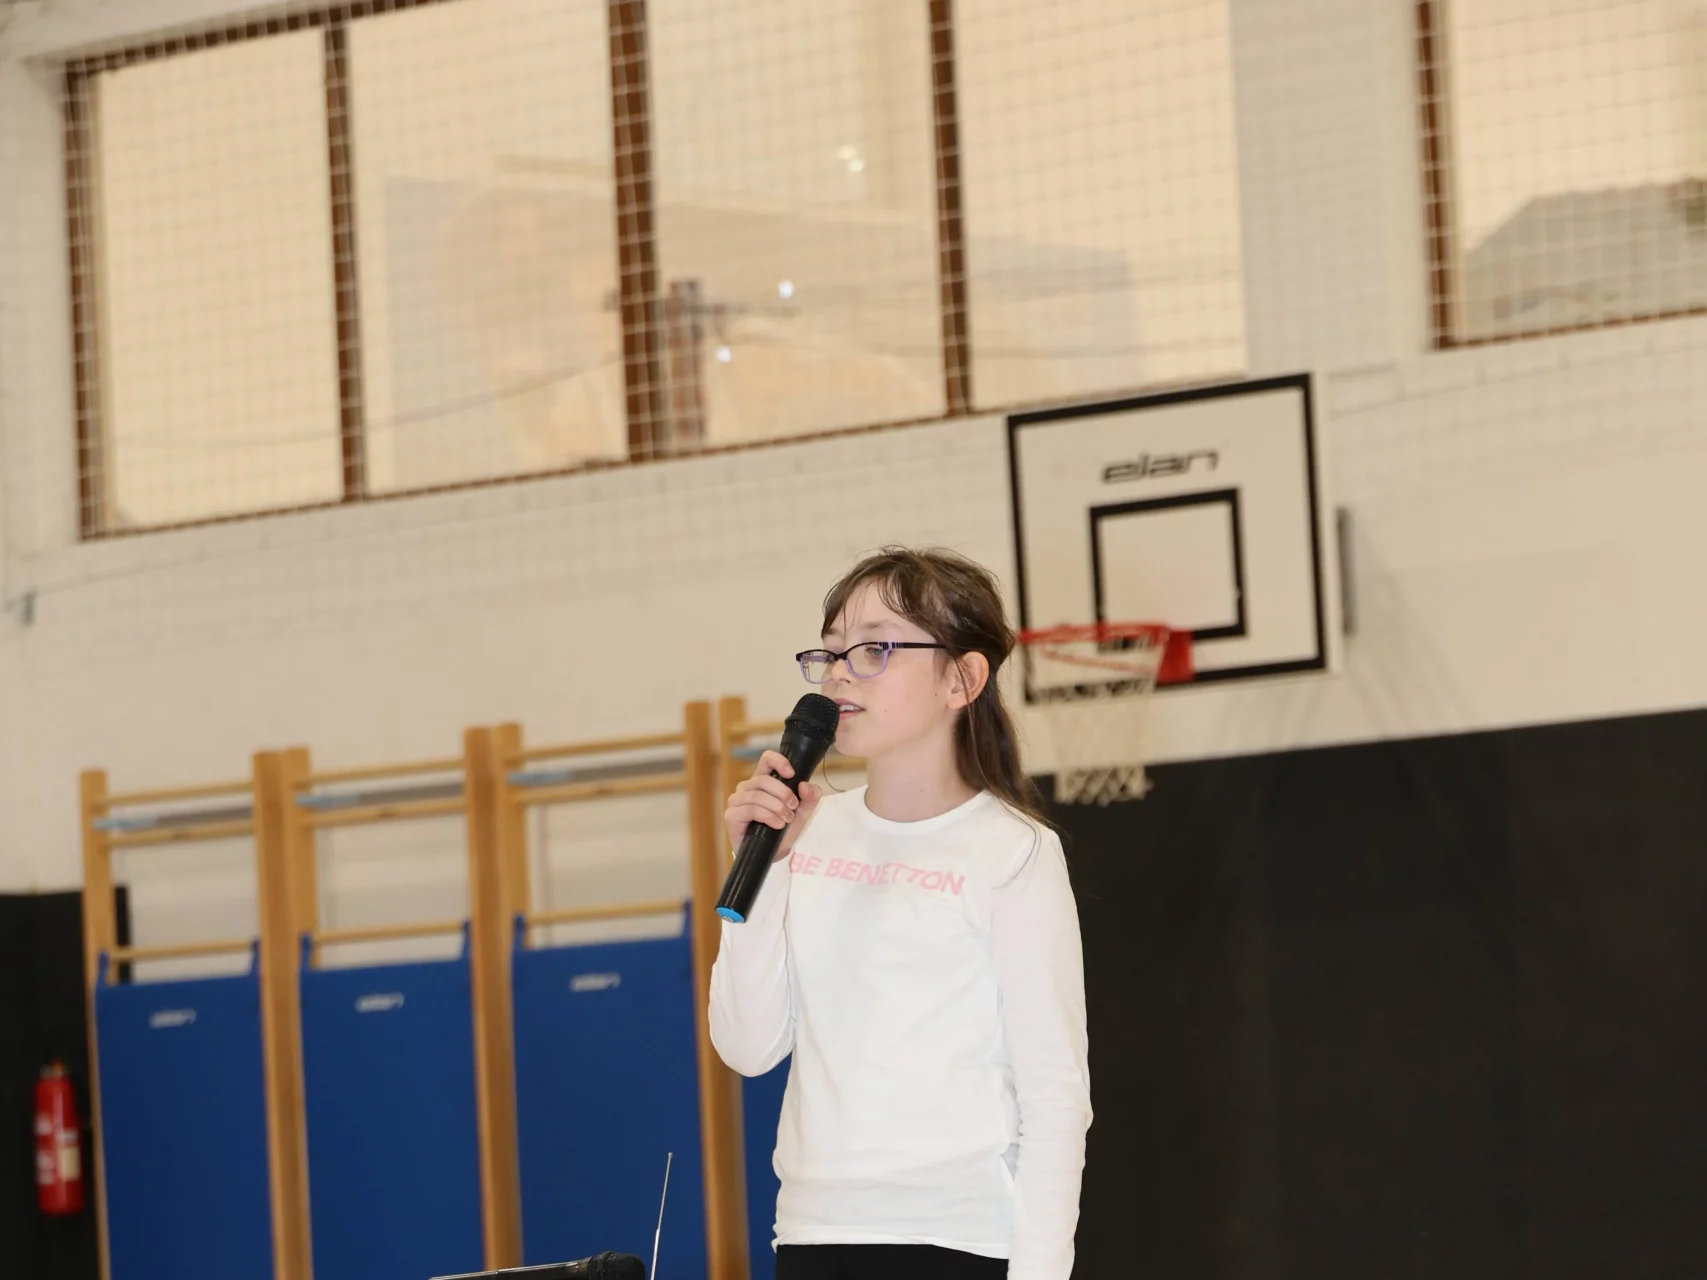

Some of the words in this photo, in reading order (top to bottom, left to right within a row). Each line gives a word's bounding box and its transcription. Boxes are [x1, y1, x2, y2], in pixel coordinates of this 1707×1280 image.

[1102, 450, 1219, 484] elan
[790, 852, 823, 876] BE
[824, 857, 966, 896] BENETTON
